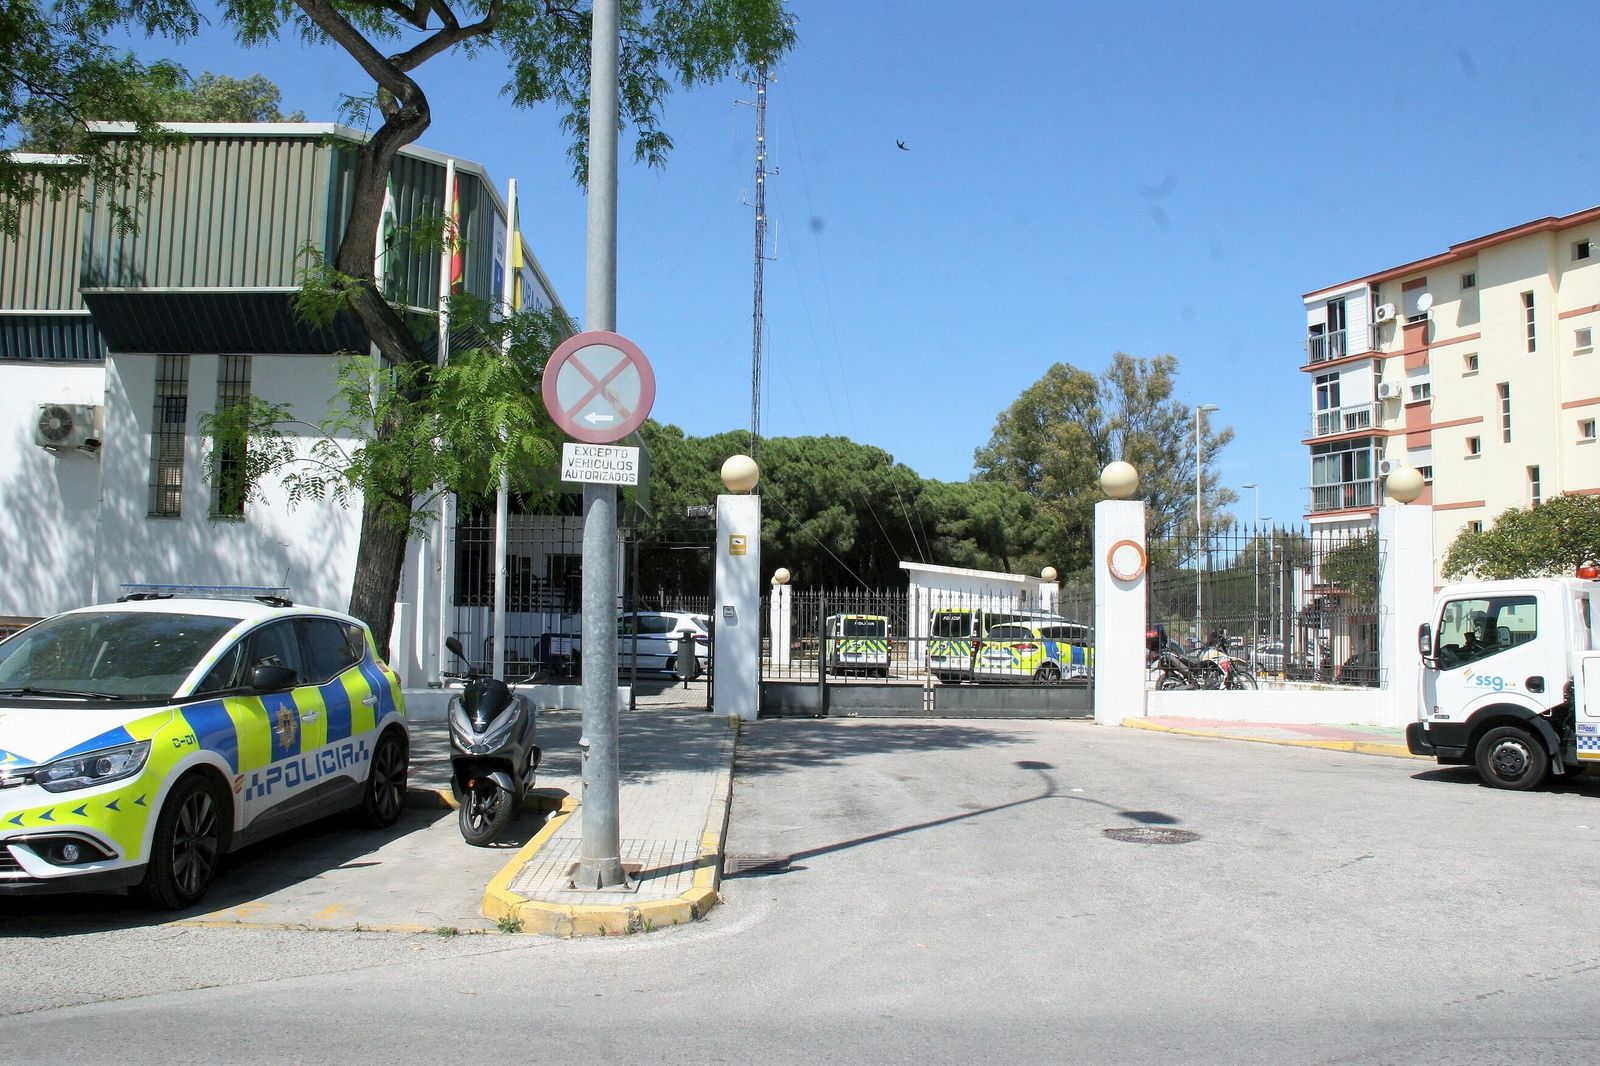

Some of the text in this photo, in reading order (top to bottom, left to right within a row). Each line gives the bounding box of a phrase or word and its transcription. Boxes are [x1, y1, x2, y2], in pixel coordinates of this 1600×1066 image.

[574, 446, 628, 459] EXCEPTO
[568, 458, 633, 470] VEHICULOS
[564, 470, 636, 483] AUTORIZADOS
[1476, 675, 1503, 691] ssg
[266, 743, 354, 795] POLICIA
